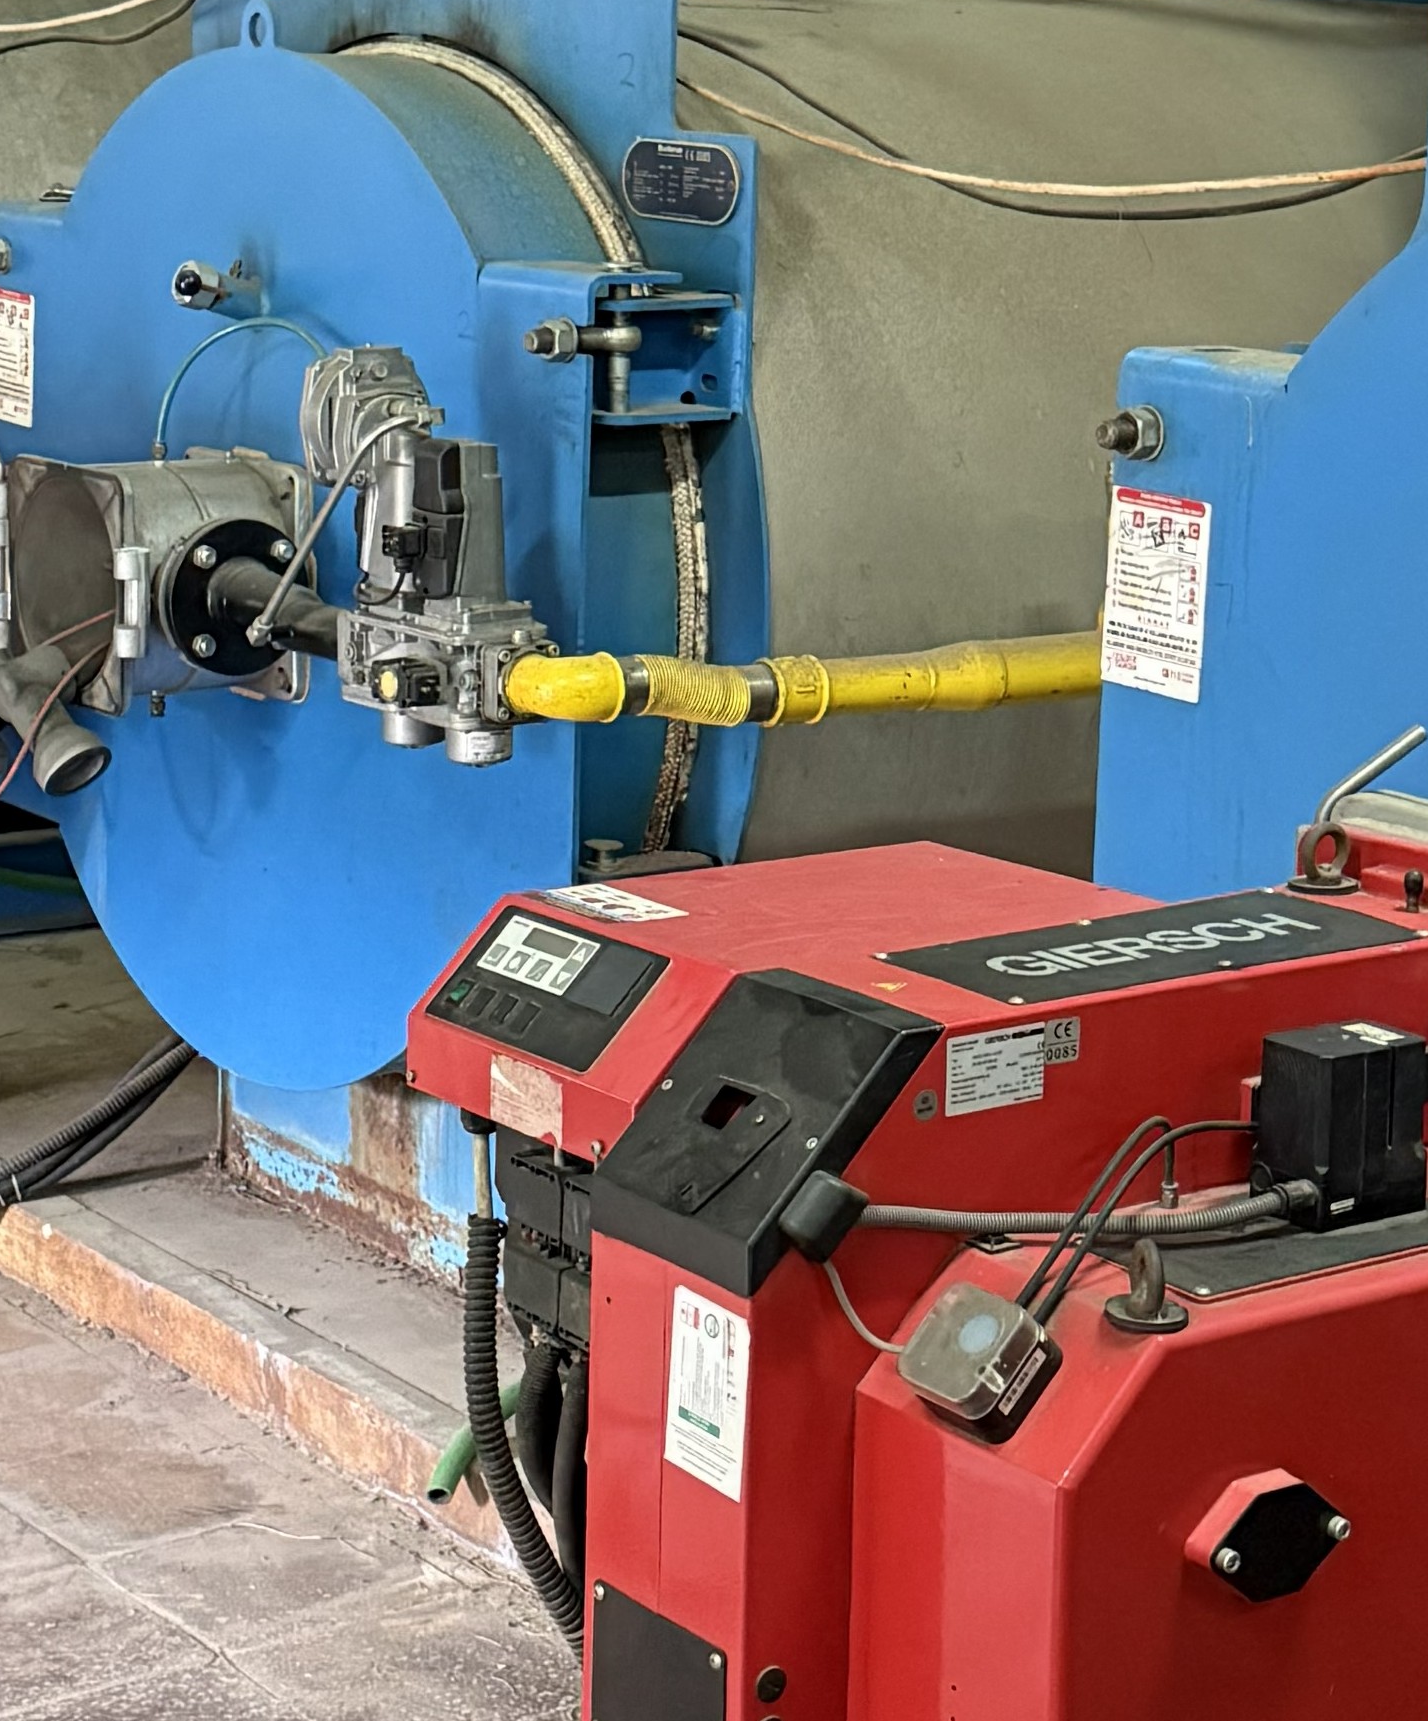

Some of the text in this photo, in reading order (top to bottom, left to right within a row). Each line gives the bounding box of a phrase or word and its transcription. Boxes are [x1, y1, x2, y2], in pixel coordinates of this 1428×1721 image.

[985, 913, 1322, 977] GIERSCH
[1054, 1020, 1073, 1039] CE
[1046, 1044, 1078, 1062] 0085
